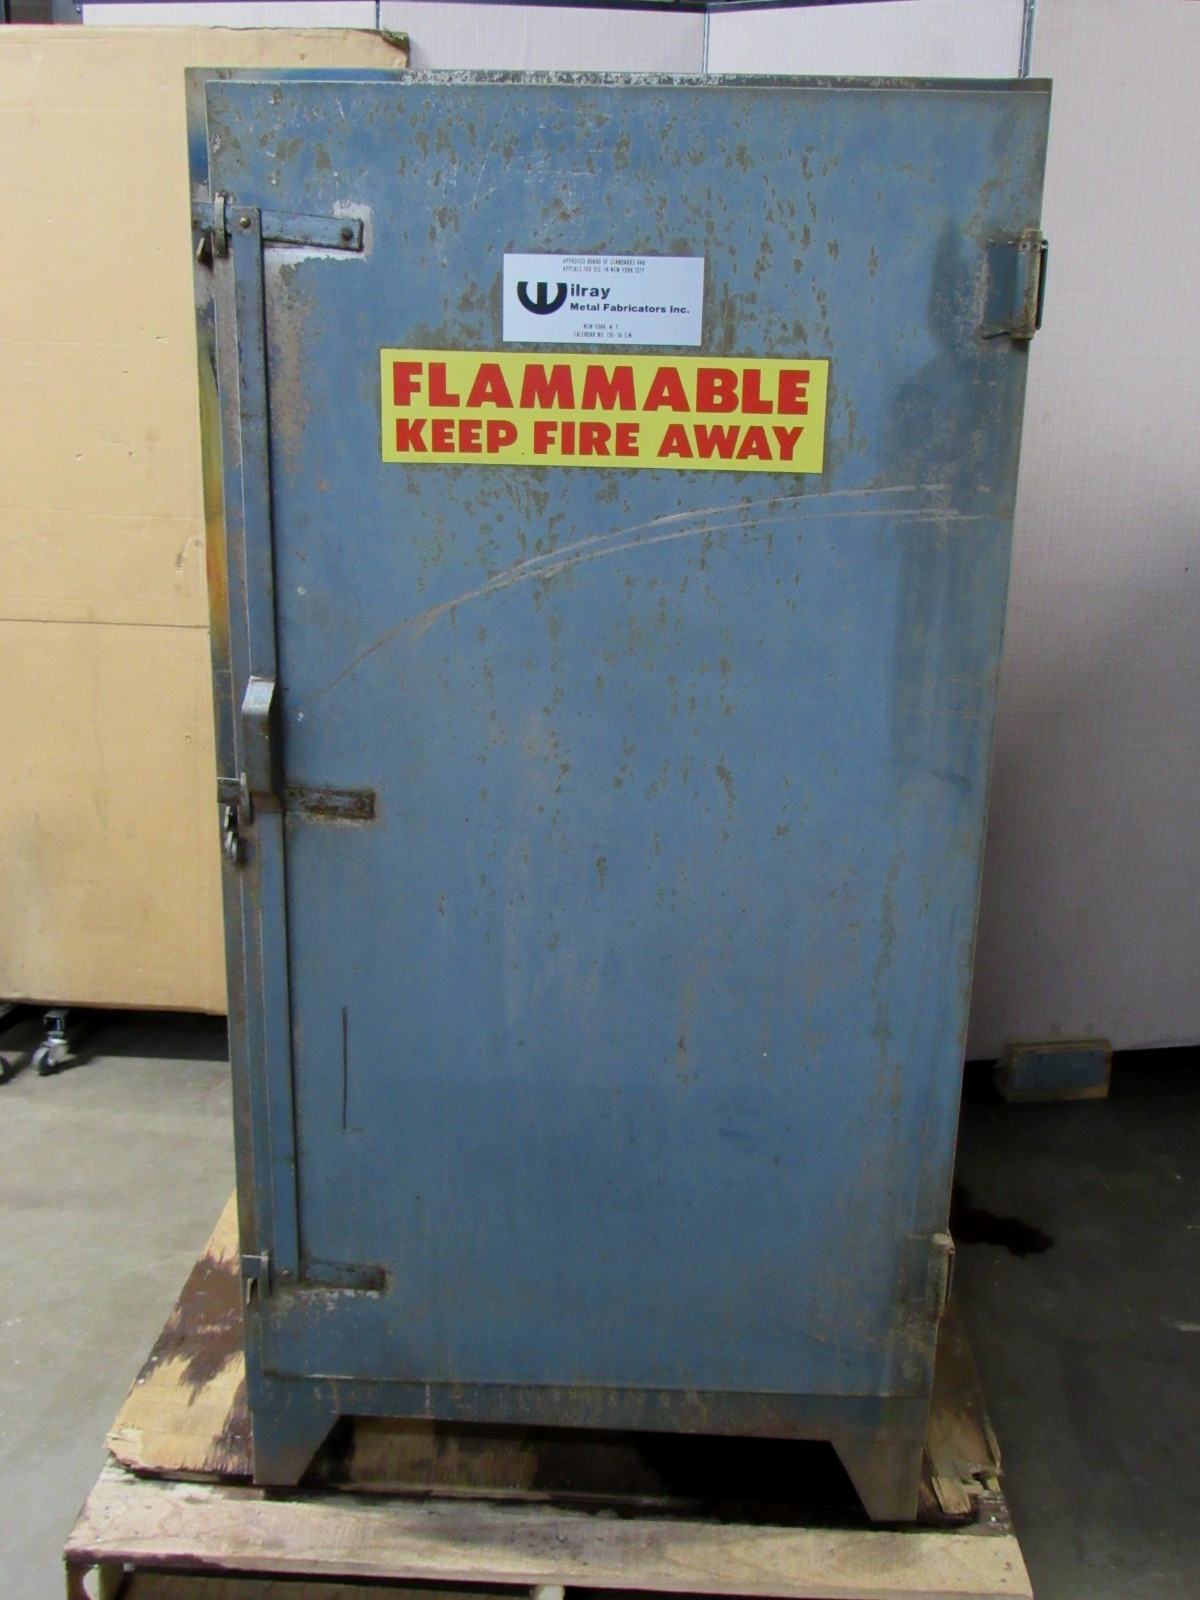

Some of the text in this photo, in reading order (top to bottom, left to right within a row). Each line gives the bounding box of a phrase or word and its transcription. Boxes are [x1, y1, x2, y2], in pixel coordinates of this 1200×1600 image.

[562, 257, 586, 265] APPROVED
[610, 258, 635, 266] STANDARDS
[562, 265, 582, 273] APPEALS
[583, 265, 592, 273] FOR
[621, 266, 633, 274] YORK
[570, 302, 690, 314] Metal Fabricators Inc.
[573, 330, 595, 338] CALENDAR
[393, 361, 810, 415] FLAMMABLE
[396, 418, 804, 461] KEEP FIRE AWAY
